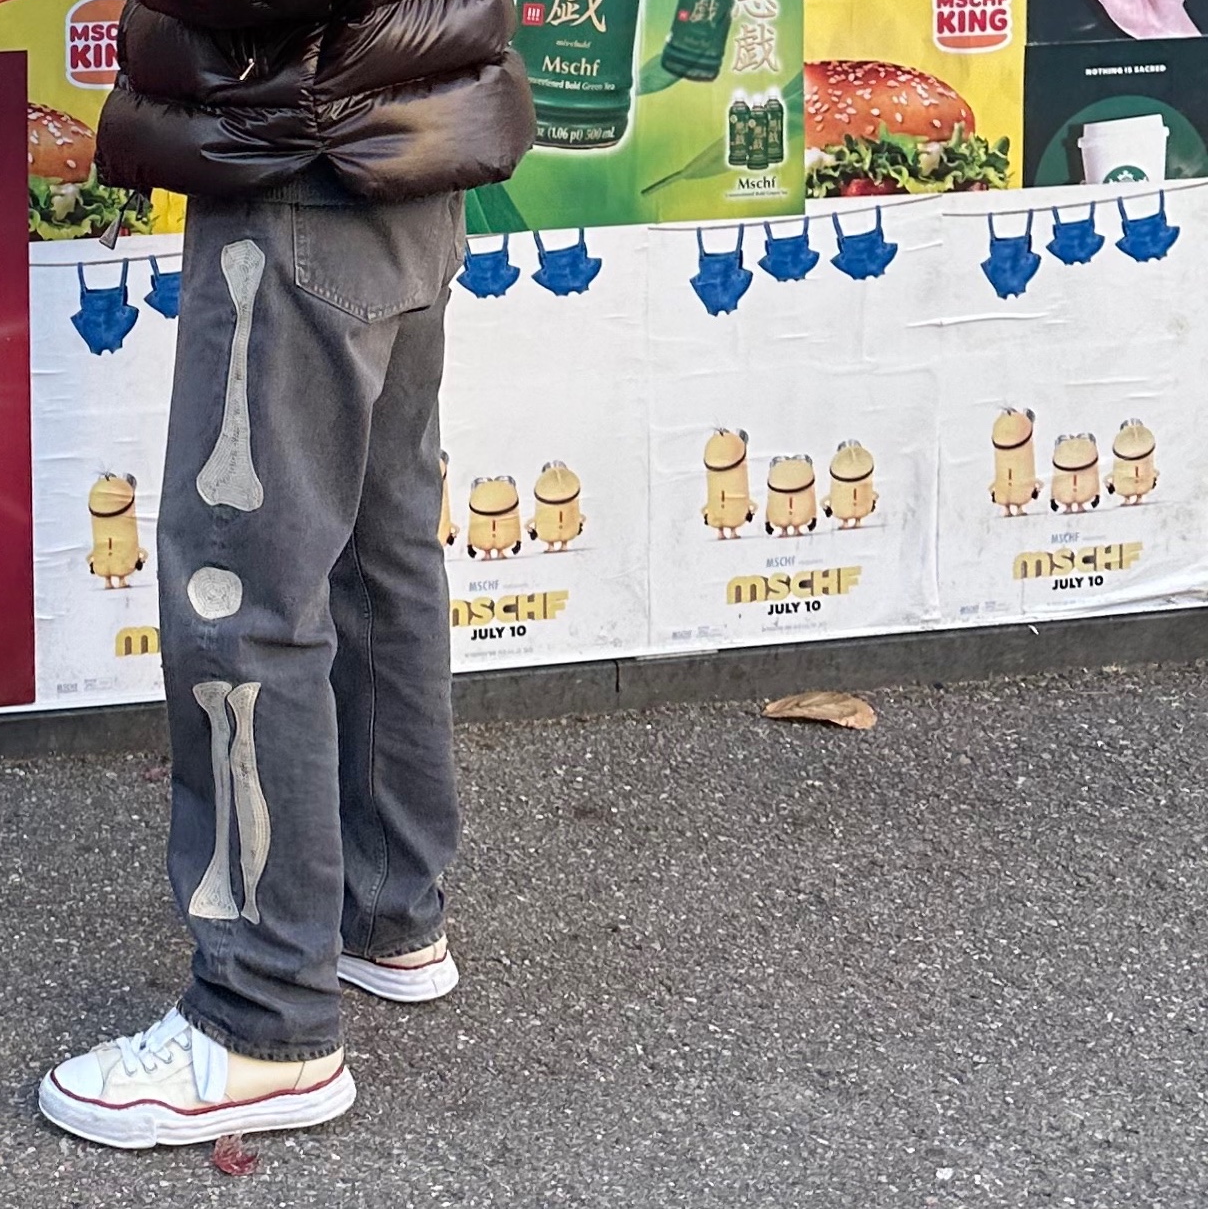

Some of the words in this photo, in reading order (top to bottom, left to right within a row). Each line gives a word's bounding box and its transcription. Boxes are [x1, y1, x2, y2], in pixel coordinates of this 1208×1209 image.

[937, 8, 1008, 33] KING
[70, 22, 119, 43] MSC
[542, 55, 601, 77] Mschf
[1085, 67, 1123, 75] NOTHING
[1125, 66, 1132, 74] IS
[739, 176, 776, 189] Mschf
[766, 556, 796, 568] MSCHF
[469, 580, 499, 592] MSCHF
[1052, 577, 1084, 591] JULY
[1088, 576, 1104, 587] 10
[767, 602, 801, 615] JULY
[804, 600, 821, 612] 10
[471, 627, 505, 641] JULY
[509, 625, 527, 637] 10
